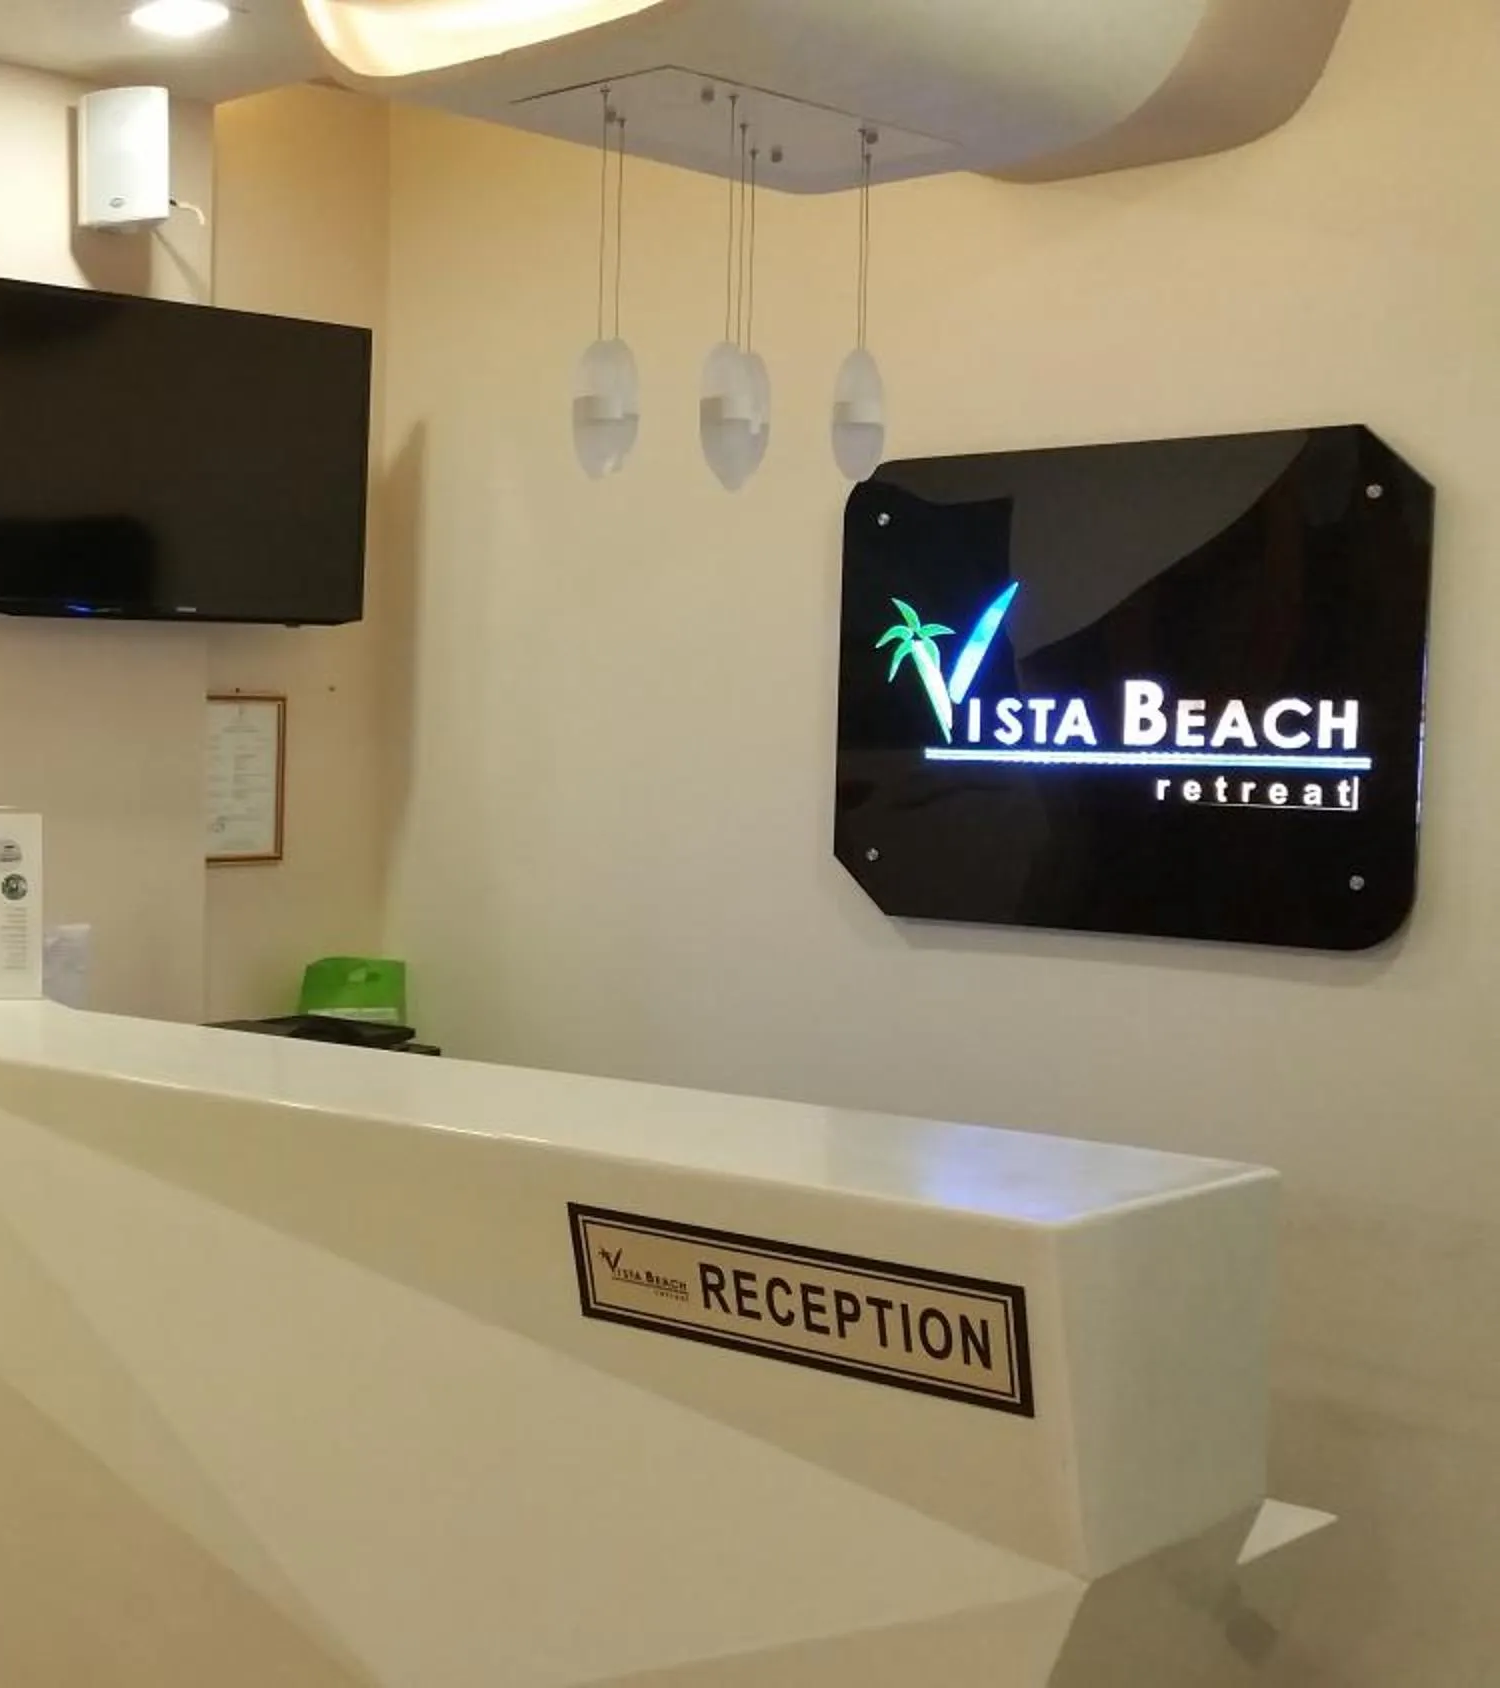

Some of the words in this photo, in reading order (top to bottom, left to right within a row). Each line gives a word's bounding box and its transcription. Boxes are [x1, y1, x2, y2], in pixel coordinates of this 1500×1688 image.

[875, 581, 1097, 746] VISTA
[1123, 678, 1359, 749] BEACH
[1156, 776, 1352, 807] retreat
[699, 1262, 992, 1370] RECEPTION
